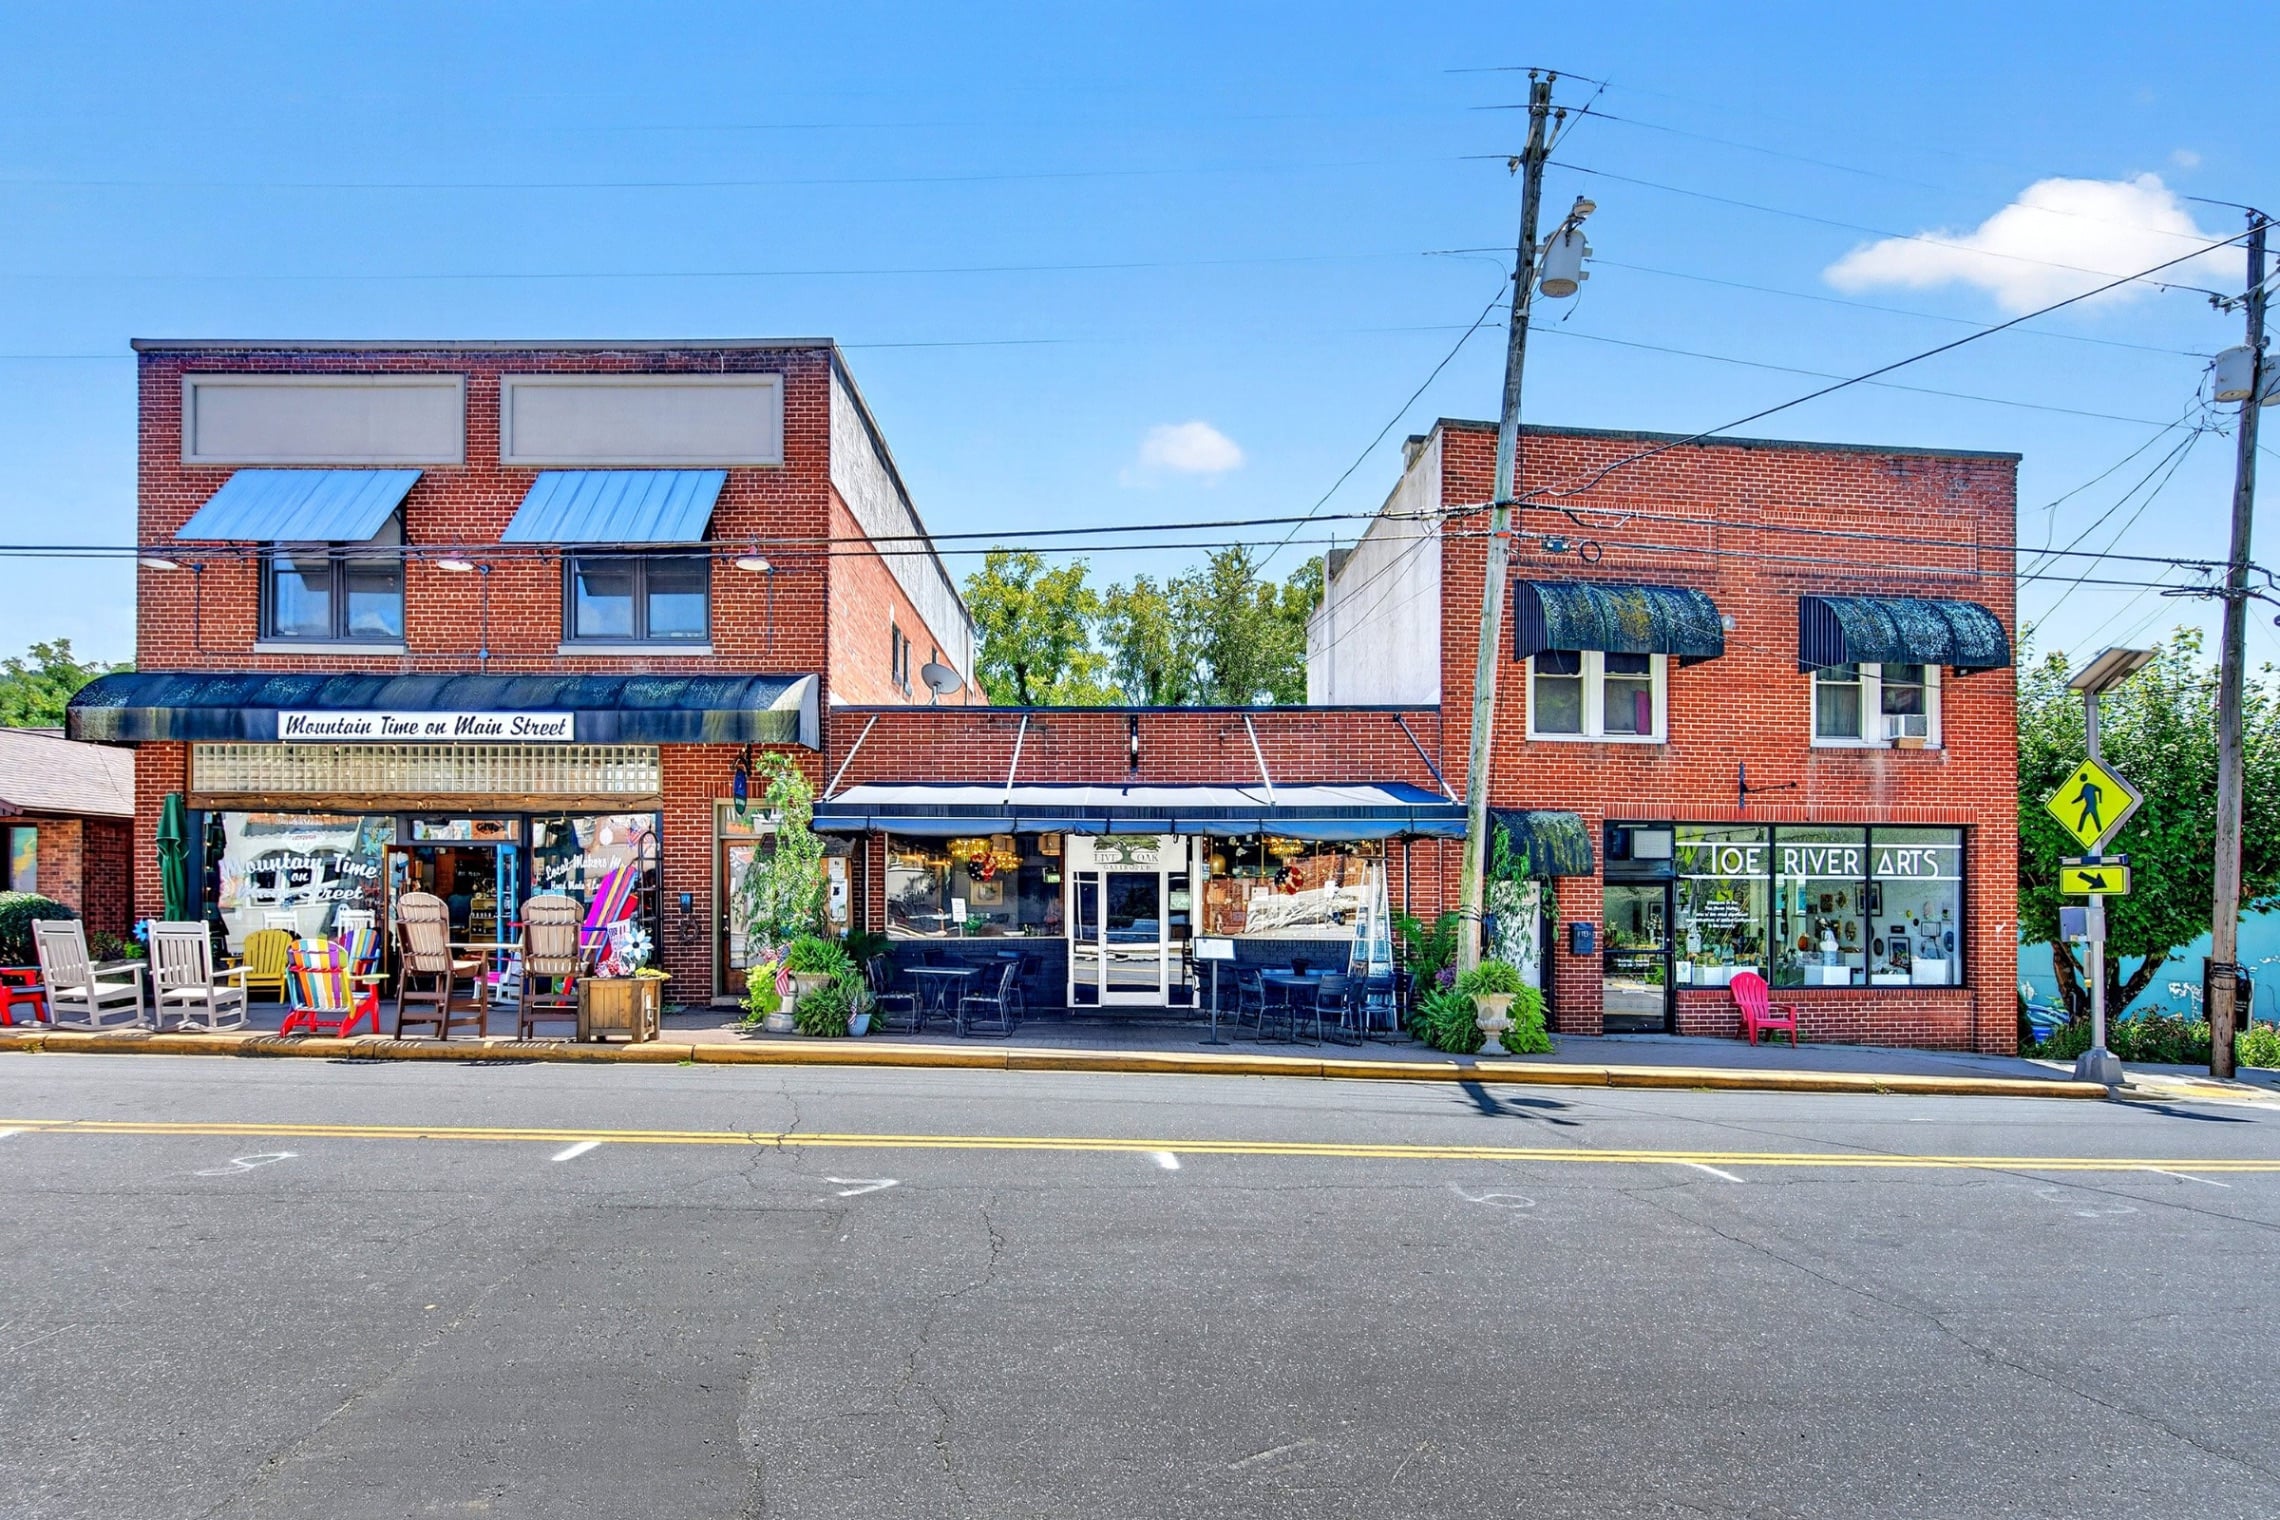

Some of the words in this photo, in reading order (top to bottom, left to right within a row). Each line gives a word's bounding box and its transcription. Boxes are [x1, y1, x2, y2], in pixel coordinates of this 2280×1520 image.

[286, 715, 372, 735] Mountain
[380, 715, 419, 735] Time
[424, 721, 446, 735] on
[454, 715, 504, 735] Main
[510, 716, 566, 736] Street
[332, 852, 377, 879] Time
[1136, 854, 1159, 862] OAK
[1784, 849, 1859, 875] RIVER
[1877, 849, 1939, 877] ARTS
[290, 870, 309, 882] on
